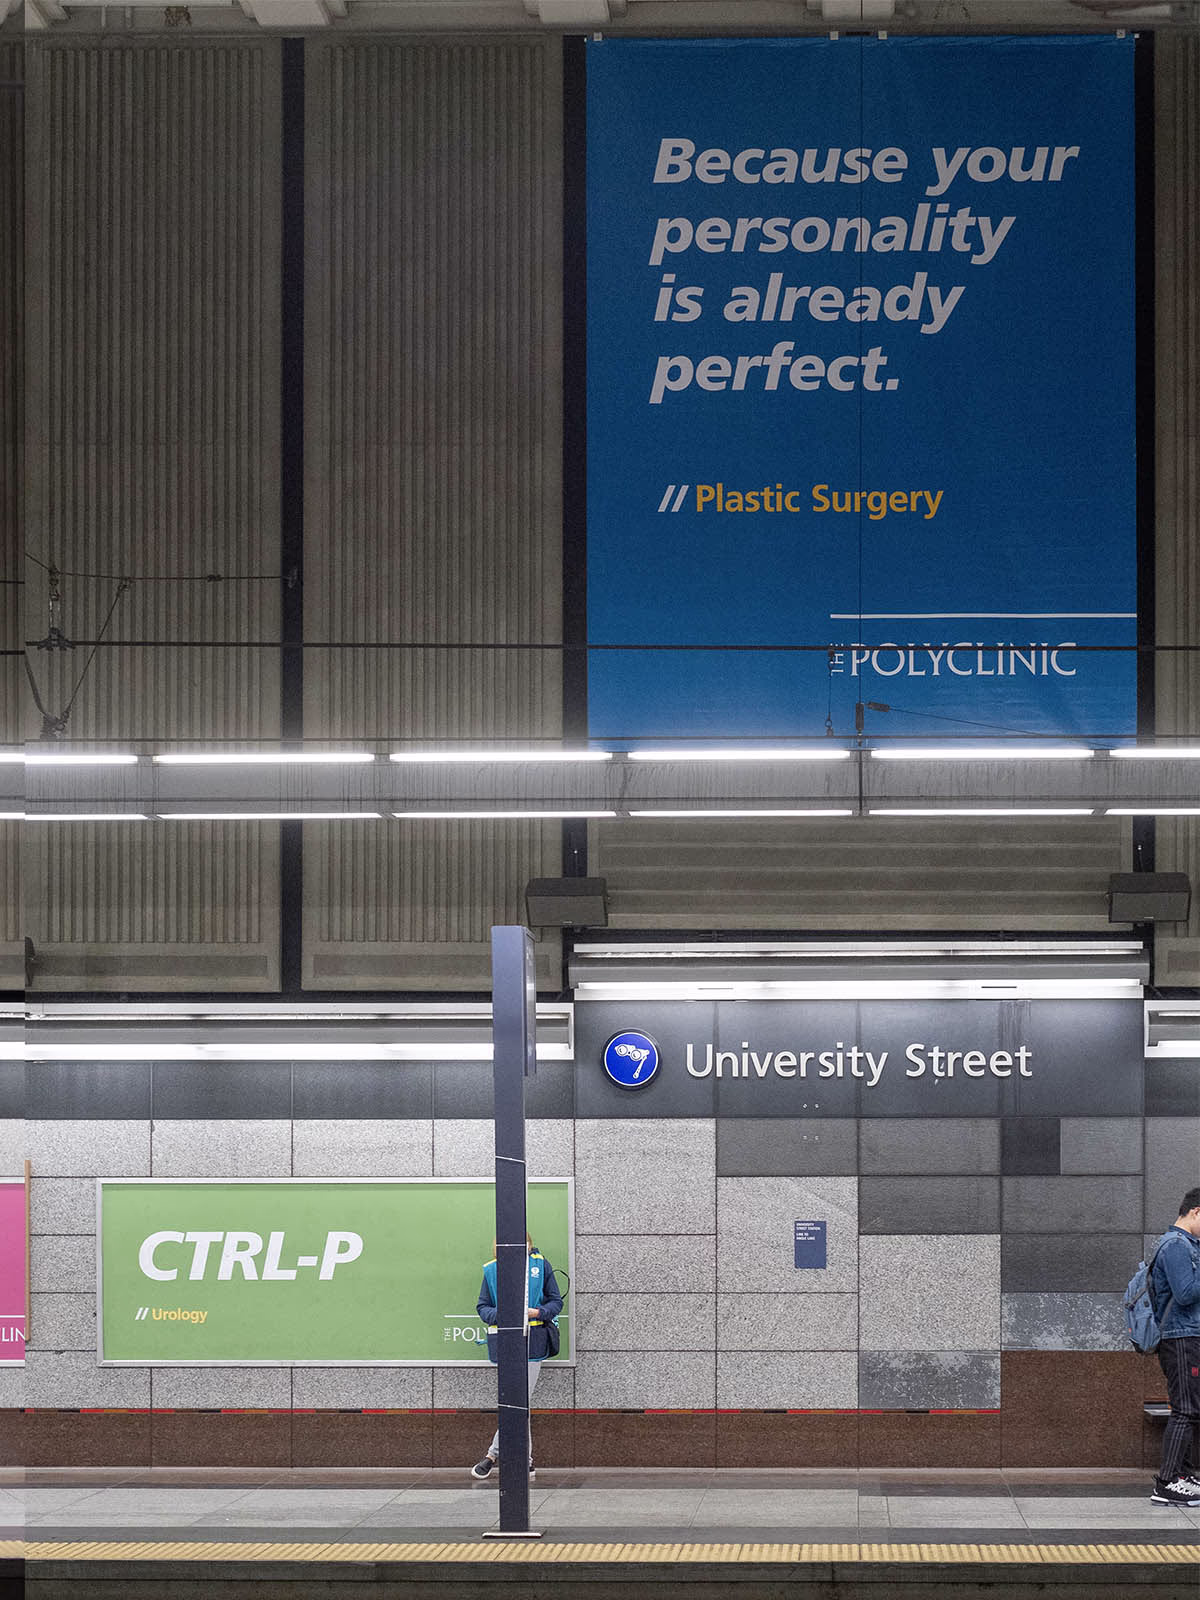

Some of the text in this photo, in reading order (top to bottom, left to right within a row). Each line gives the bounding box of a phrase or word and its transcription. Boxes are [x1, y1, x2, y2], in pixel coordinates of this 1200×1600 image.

[652, 138, 1080, 196] Because your
[649, 202, 1016, 265] personality
[653, 271, 966, 335] is already
[649, 342, 900, 405] perfect.
[696, 483, 801, 513] Plastic
[811, 484, 944, 521] Surgery
[850, 642, 1077, 676] POLYCLINIC
[686, 1041, 1033, 1087] University Street
[138, 1230, 364, 1282] CTRL-P
[152, 1307, 208, 1324] Urology
